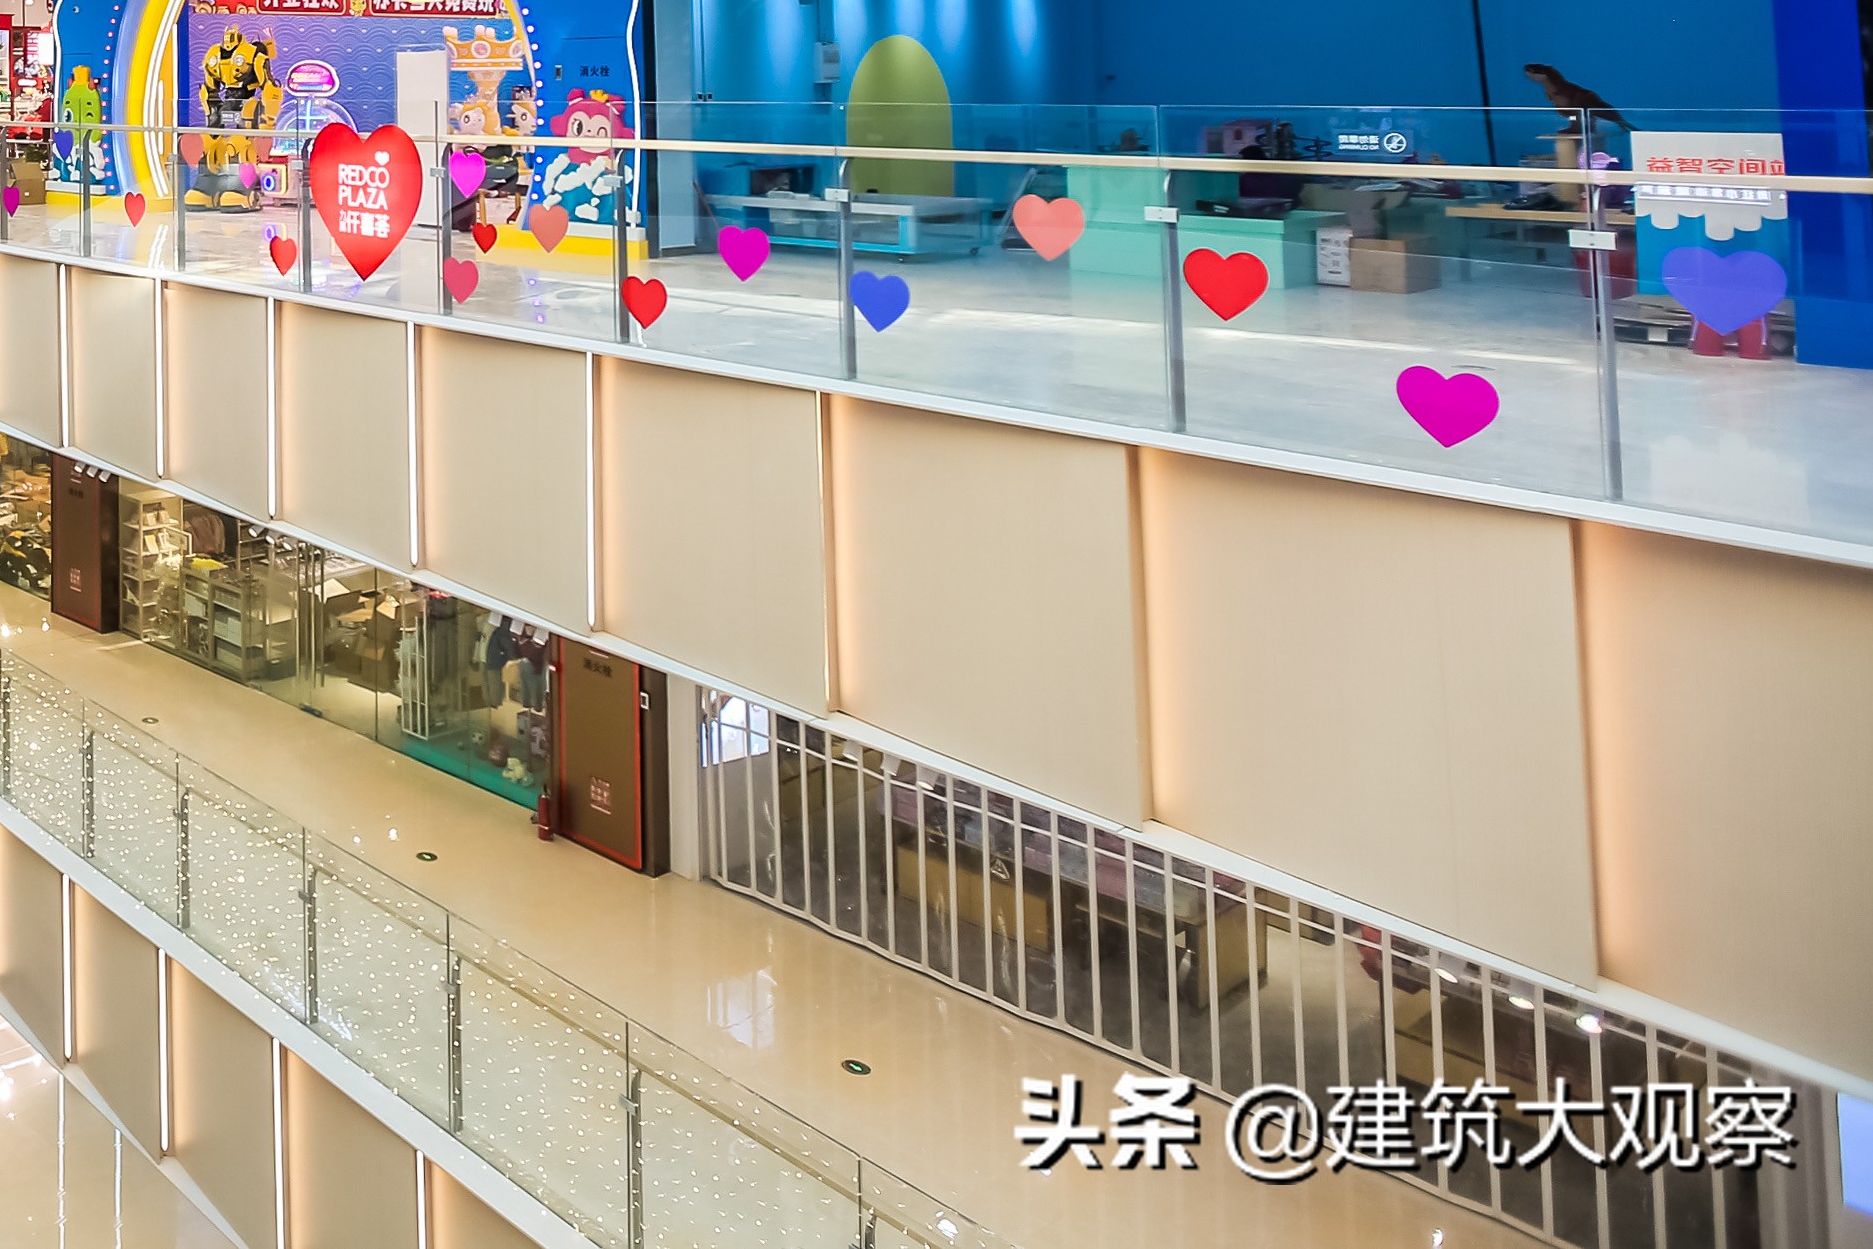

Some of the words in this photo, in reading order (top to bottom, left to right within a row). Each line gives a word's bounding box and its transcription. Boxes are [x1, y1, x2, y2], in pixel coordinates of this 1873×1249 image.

[579, 65, 611, 78] 消火栓
[338, 163, 390, 189] REDCO
[338, 184, 389, 210] PLAZA
